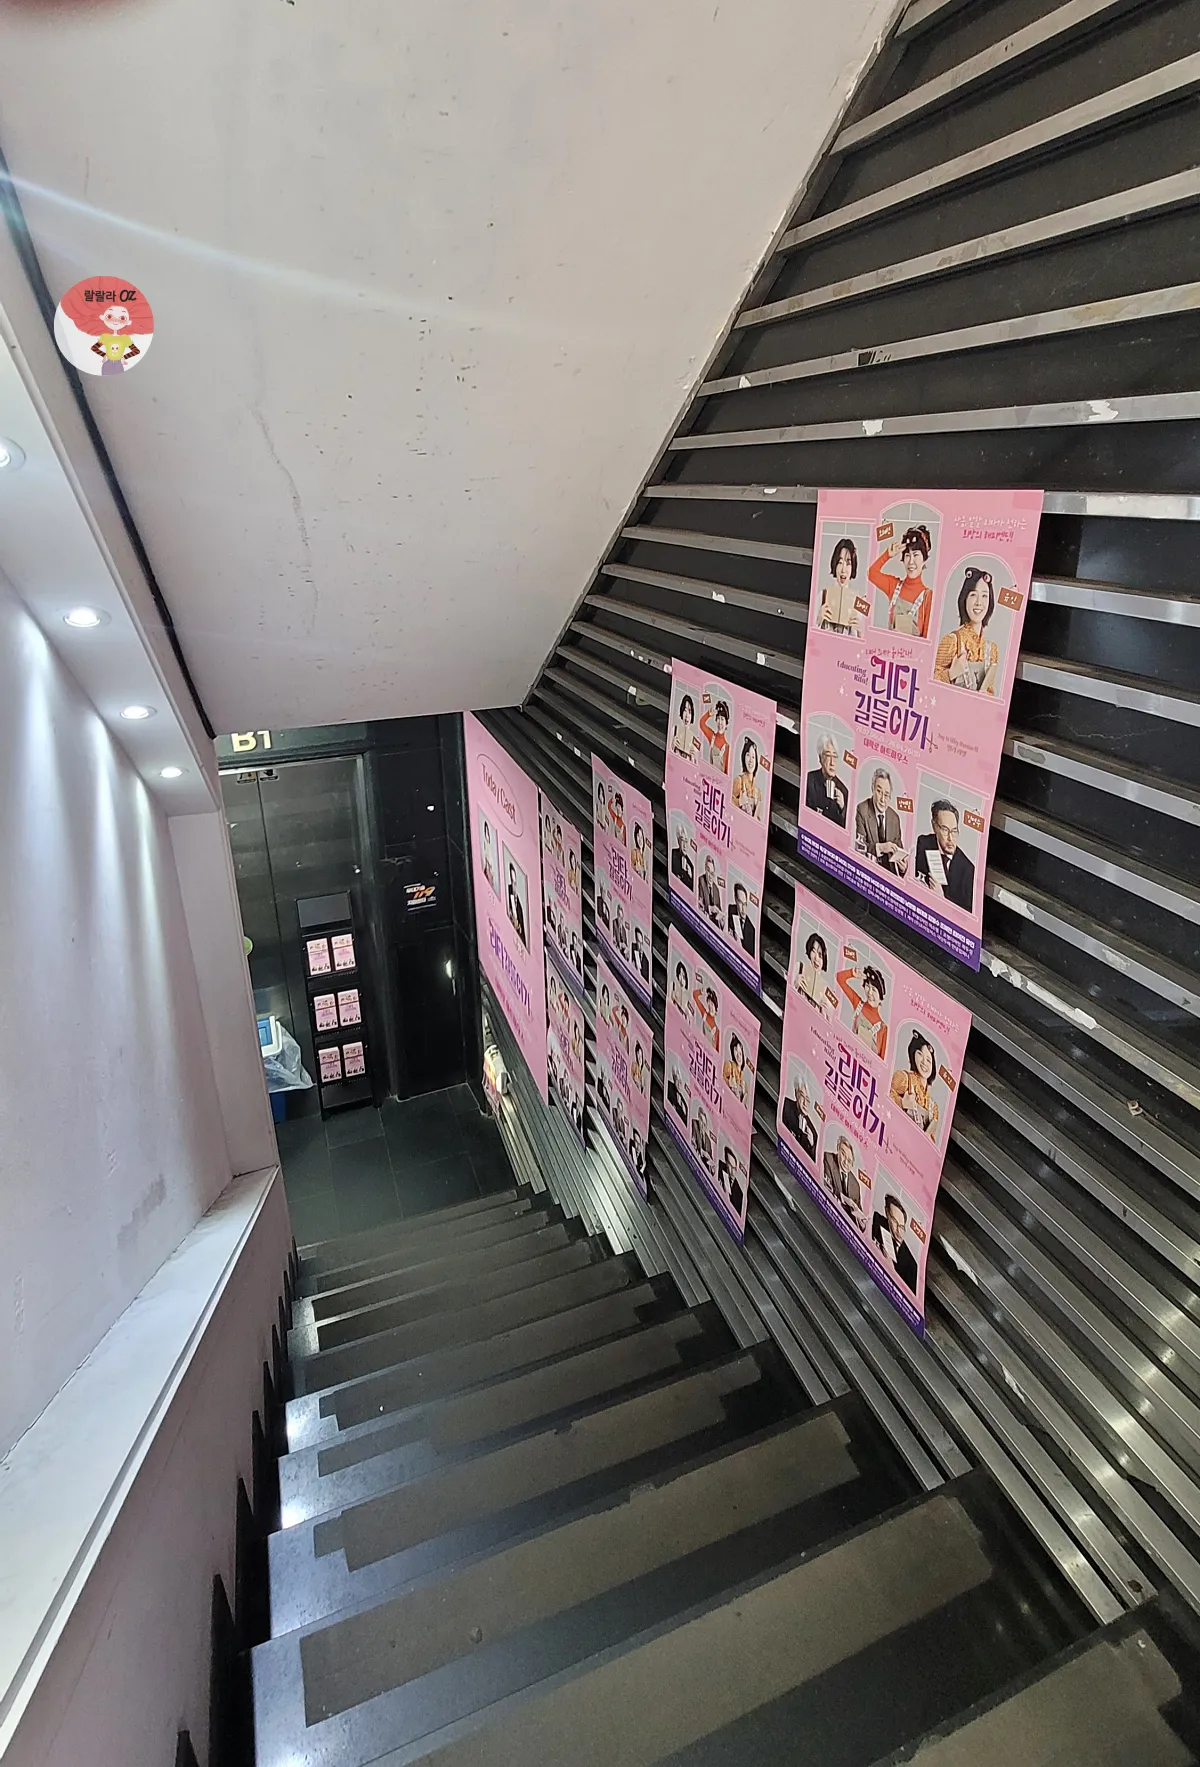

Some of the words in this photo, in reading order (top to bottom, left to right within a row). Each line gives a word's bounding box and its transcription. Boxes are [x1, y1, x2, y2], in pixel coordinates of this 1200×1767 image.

[837, 660, 868, 678] Educating
[853, 674, 869, 686] Rita!
[870, 655, 920, 708] 리타
[854, 690, 929, 750] 길들이기
[500, 788, 517, 825] Cast
[701, 778, 726, 819] 리타
[694, 799, 731, 849] 길들이기
[837, 1042, 879, 1108] 리타
[824, 1060, 885, 1148] 길들이기
